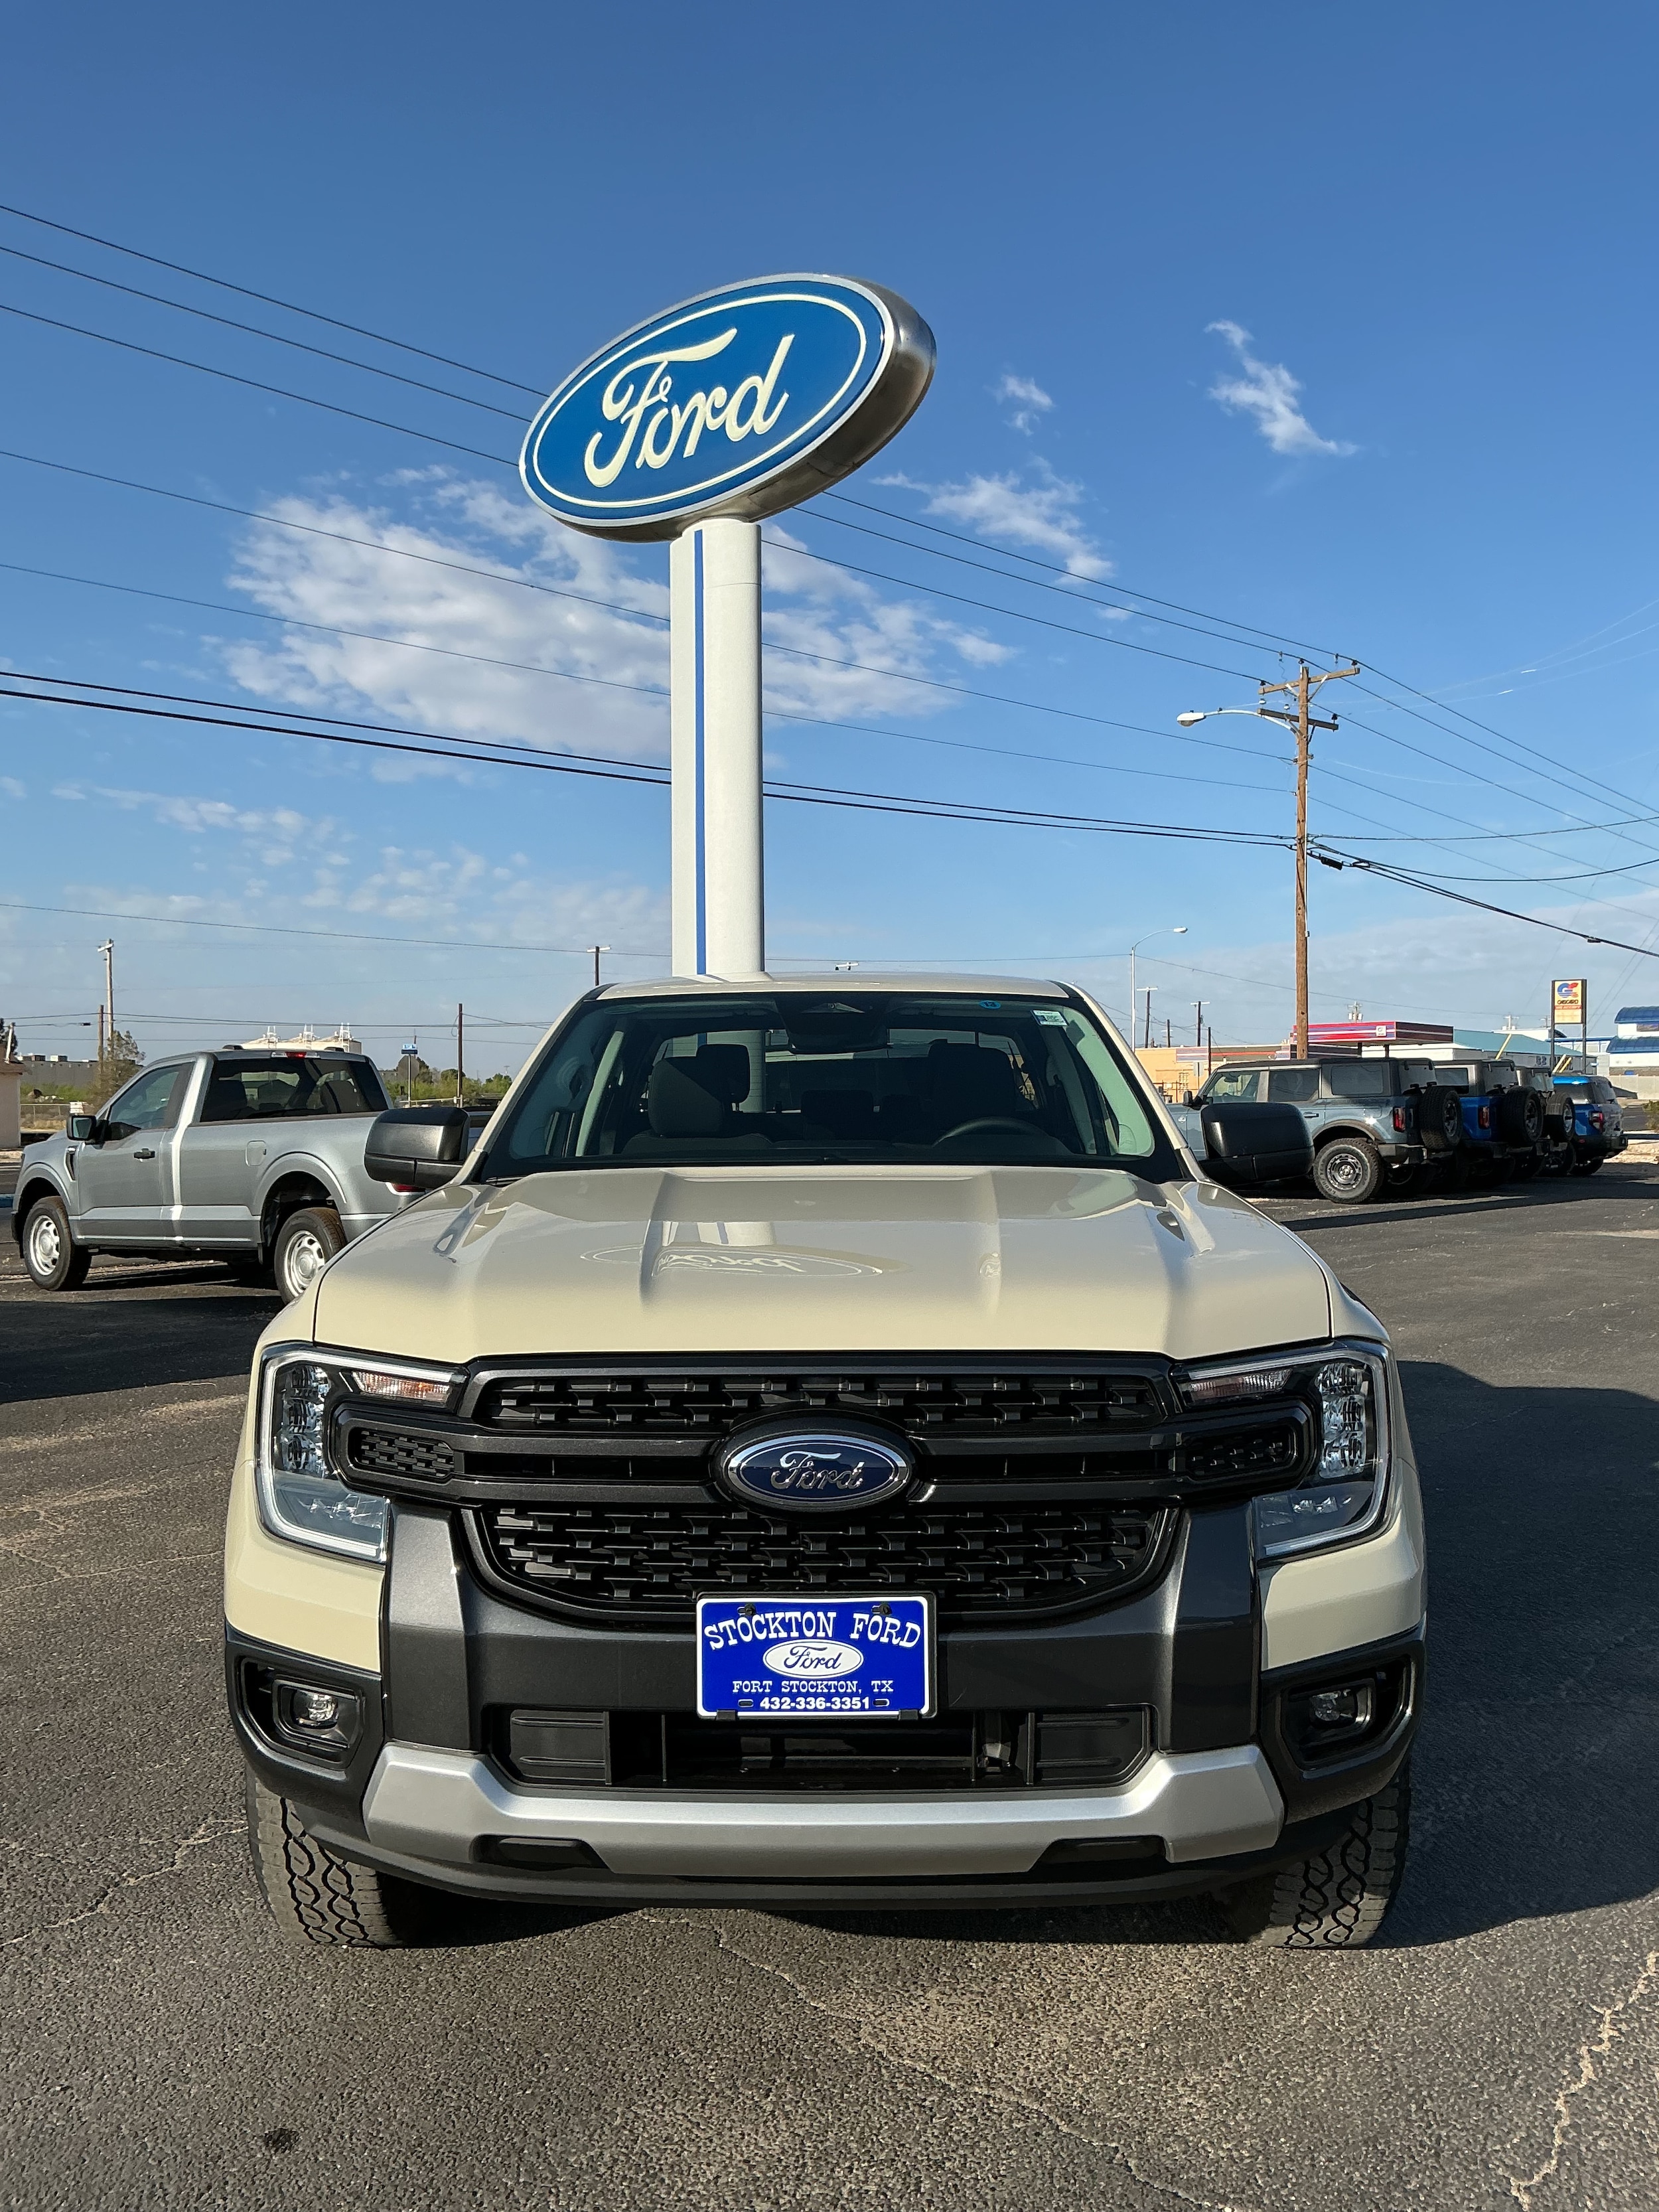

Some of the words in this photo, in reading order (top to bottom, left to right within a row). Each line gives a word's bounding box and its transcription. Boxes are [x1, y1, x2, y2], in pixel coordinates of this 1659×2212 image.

[584, 327, 795, 488] Ford
[770, 1451, 865, 1489] Ford
[704, 1611, 836, 1651] STOCKTON
[849, 1613, 921, 1648] FORD
[784, 1645, 843, 1670] Ford
[733, 1680, 772, 1692] FORT
[781, 1680, 862, 1694] STOCKTON,
[871, 1680, 894, 1692] TX
[760, 1696, 870, 1710] 432-336-3351
